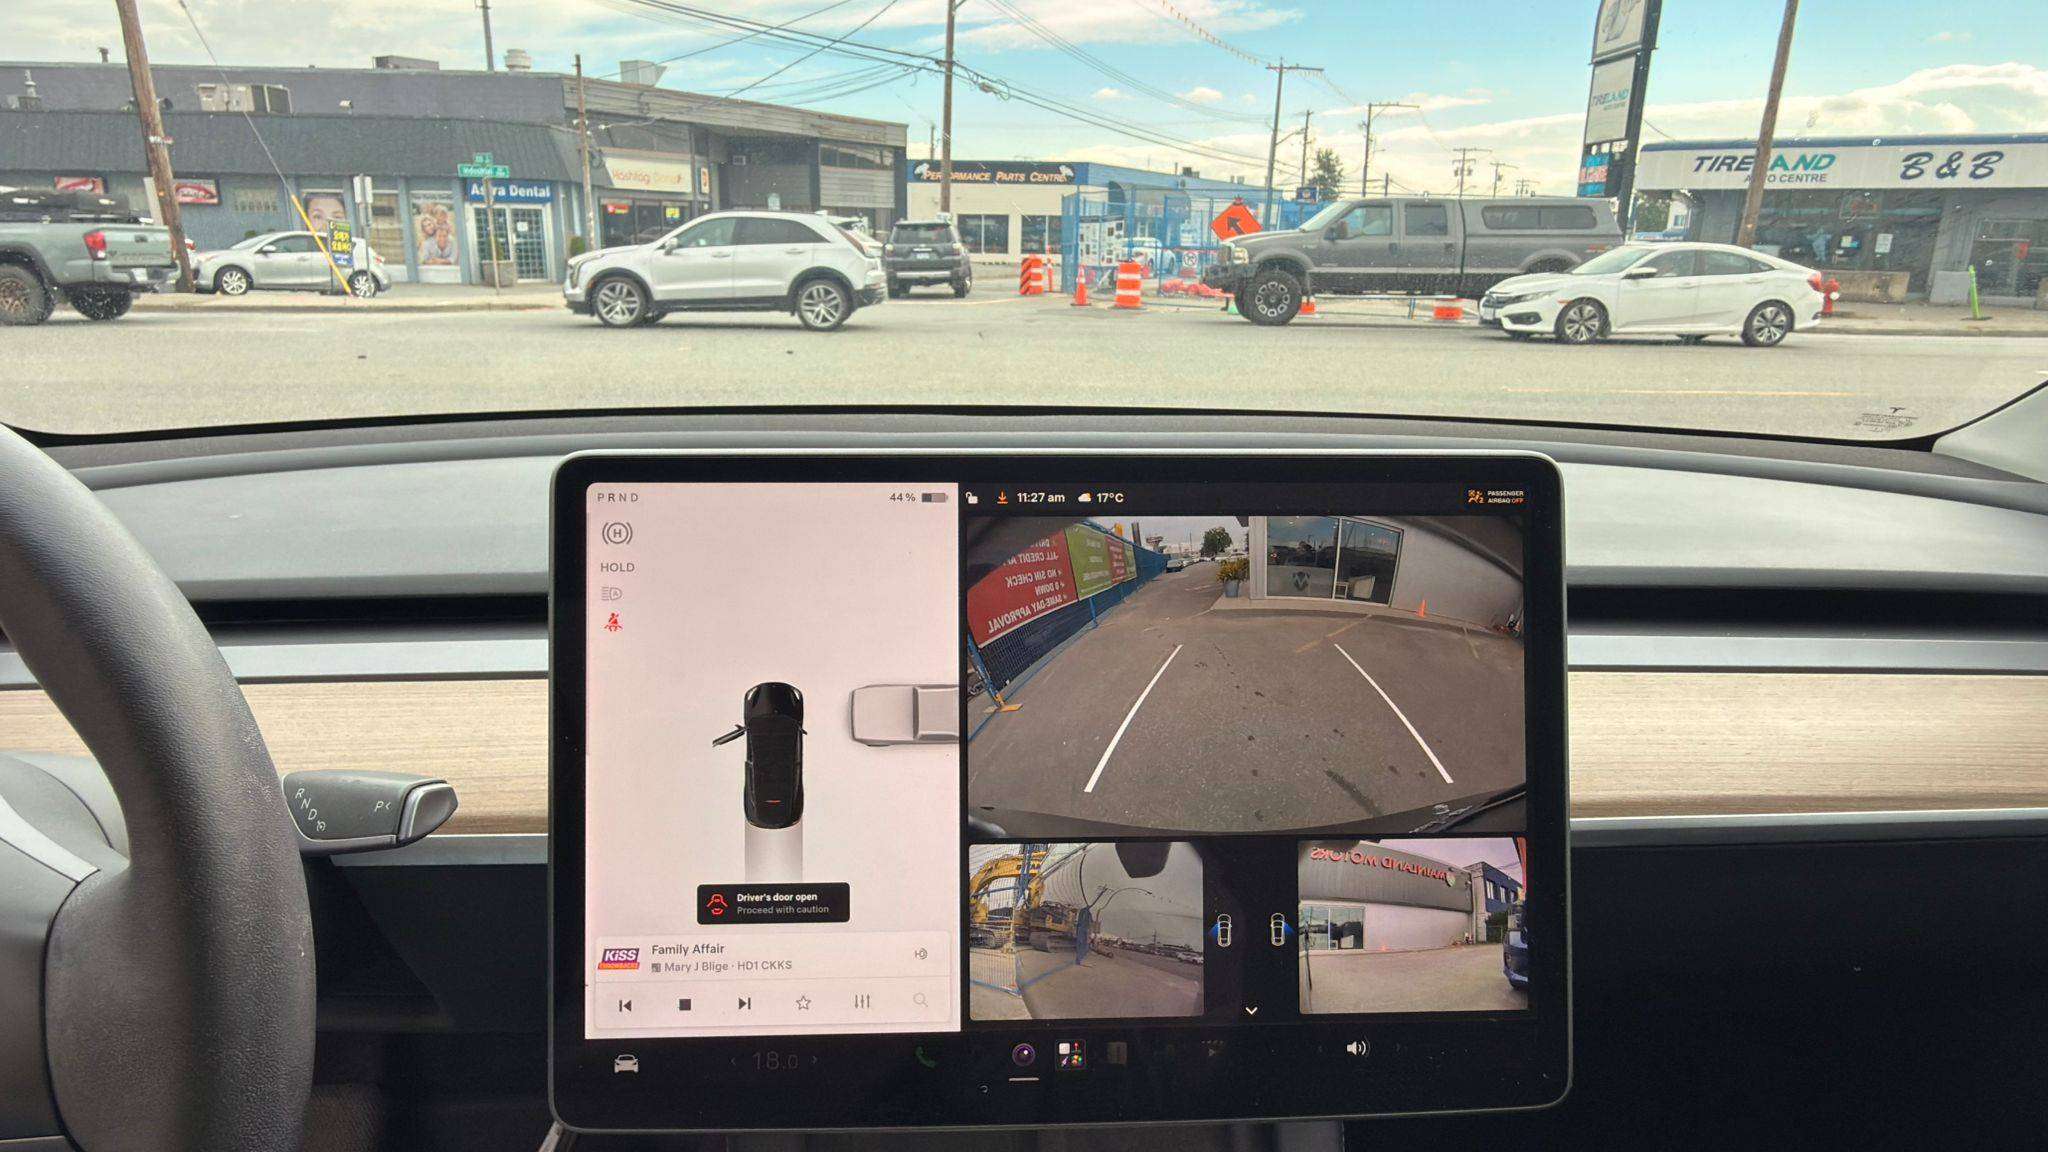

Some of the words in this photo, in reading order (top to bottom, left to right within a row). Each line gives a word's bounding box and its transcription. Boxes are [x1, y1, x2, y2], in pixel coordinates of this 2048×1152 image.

[1694, 153, 1836, 172] TIREAND
[1900, 152, 1933, 179] B
[1935, 151, 1963, 178] &
[1969, 151, 2004, 179] B
[996, 171, 1025, 182] PARTS
[1779, 173, 1828, 183] CENTRE
[471, 183, 506, 196] Asra
[509, 184, 551, 198] Dental
[1017, 492, 1044, 503] 11:27
[1047, 495, 1065, 503] am
[1097, 492, 1124, 503] 17°C
[600, 563, 635, 572] HOLD
[737, 893, 772, 902] Driver's
[773, 893, 794, 902] door
[796, 894, 818, 903] open
[737, 906, 774, 914] Proceed
[776, 905, 795, 914] with
[797, 905, 830, 914] caution
[605, 949, 638, 961] KiSS
[651, 944, 689, 956] Family
[692, 944, 725, 954] Affair
[664, 962, 692, 973] Mary
[701, 961, 729, 973] Blige
[761, 960, 792, 970] CKKS
